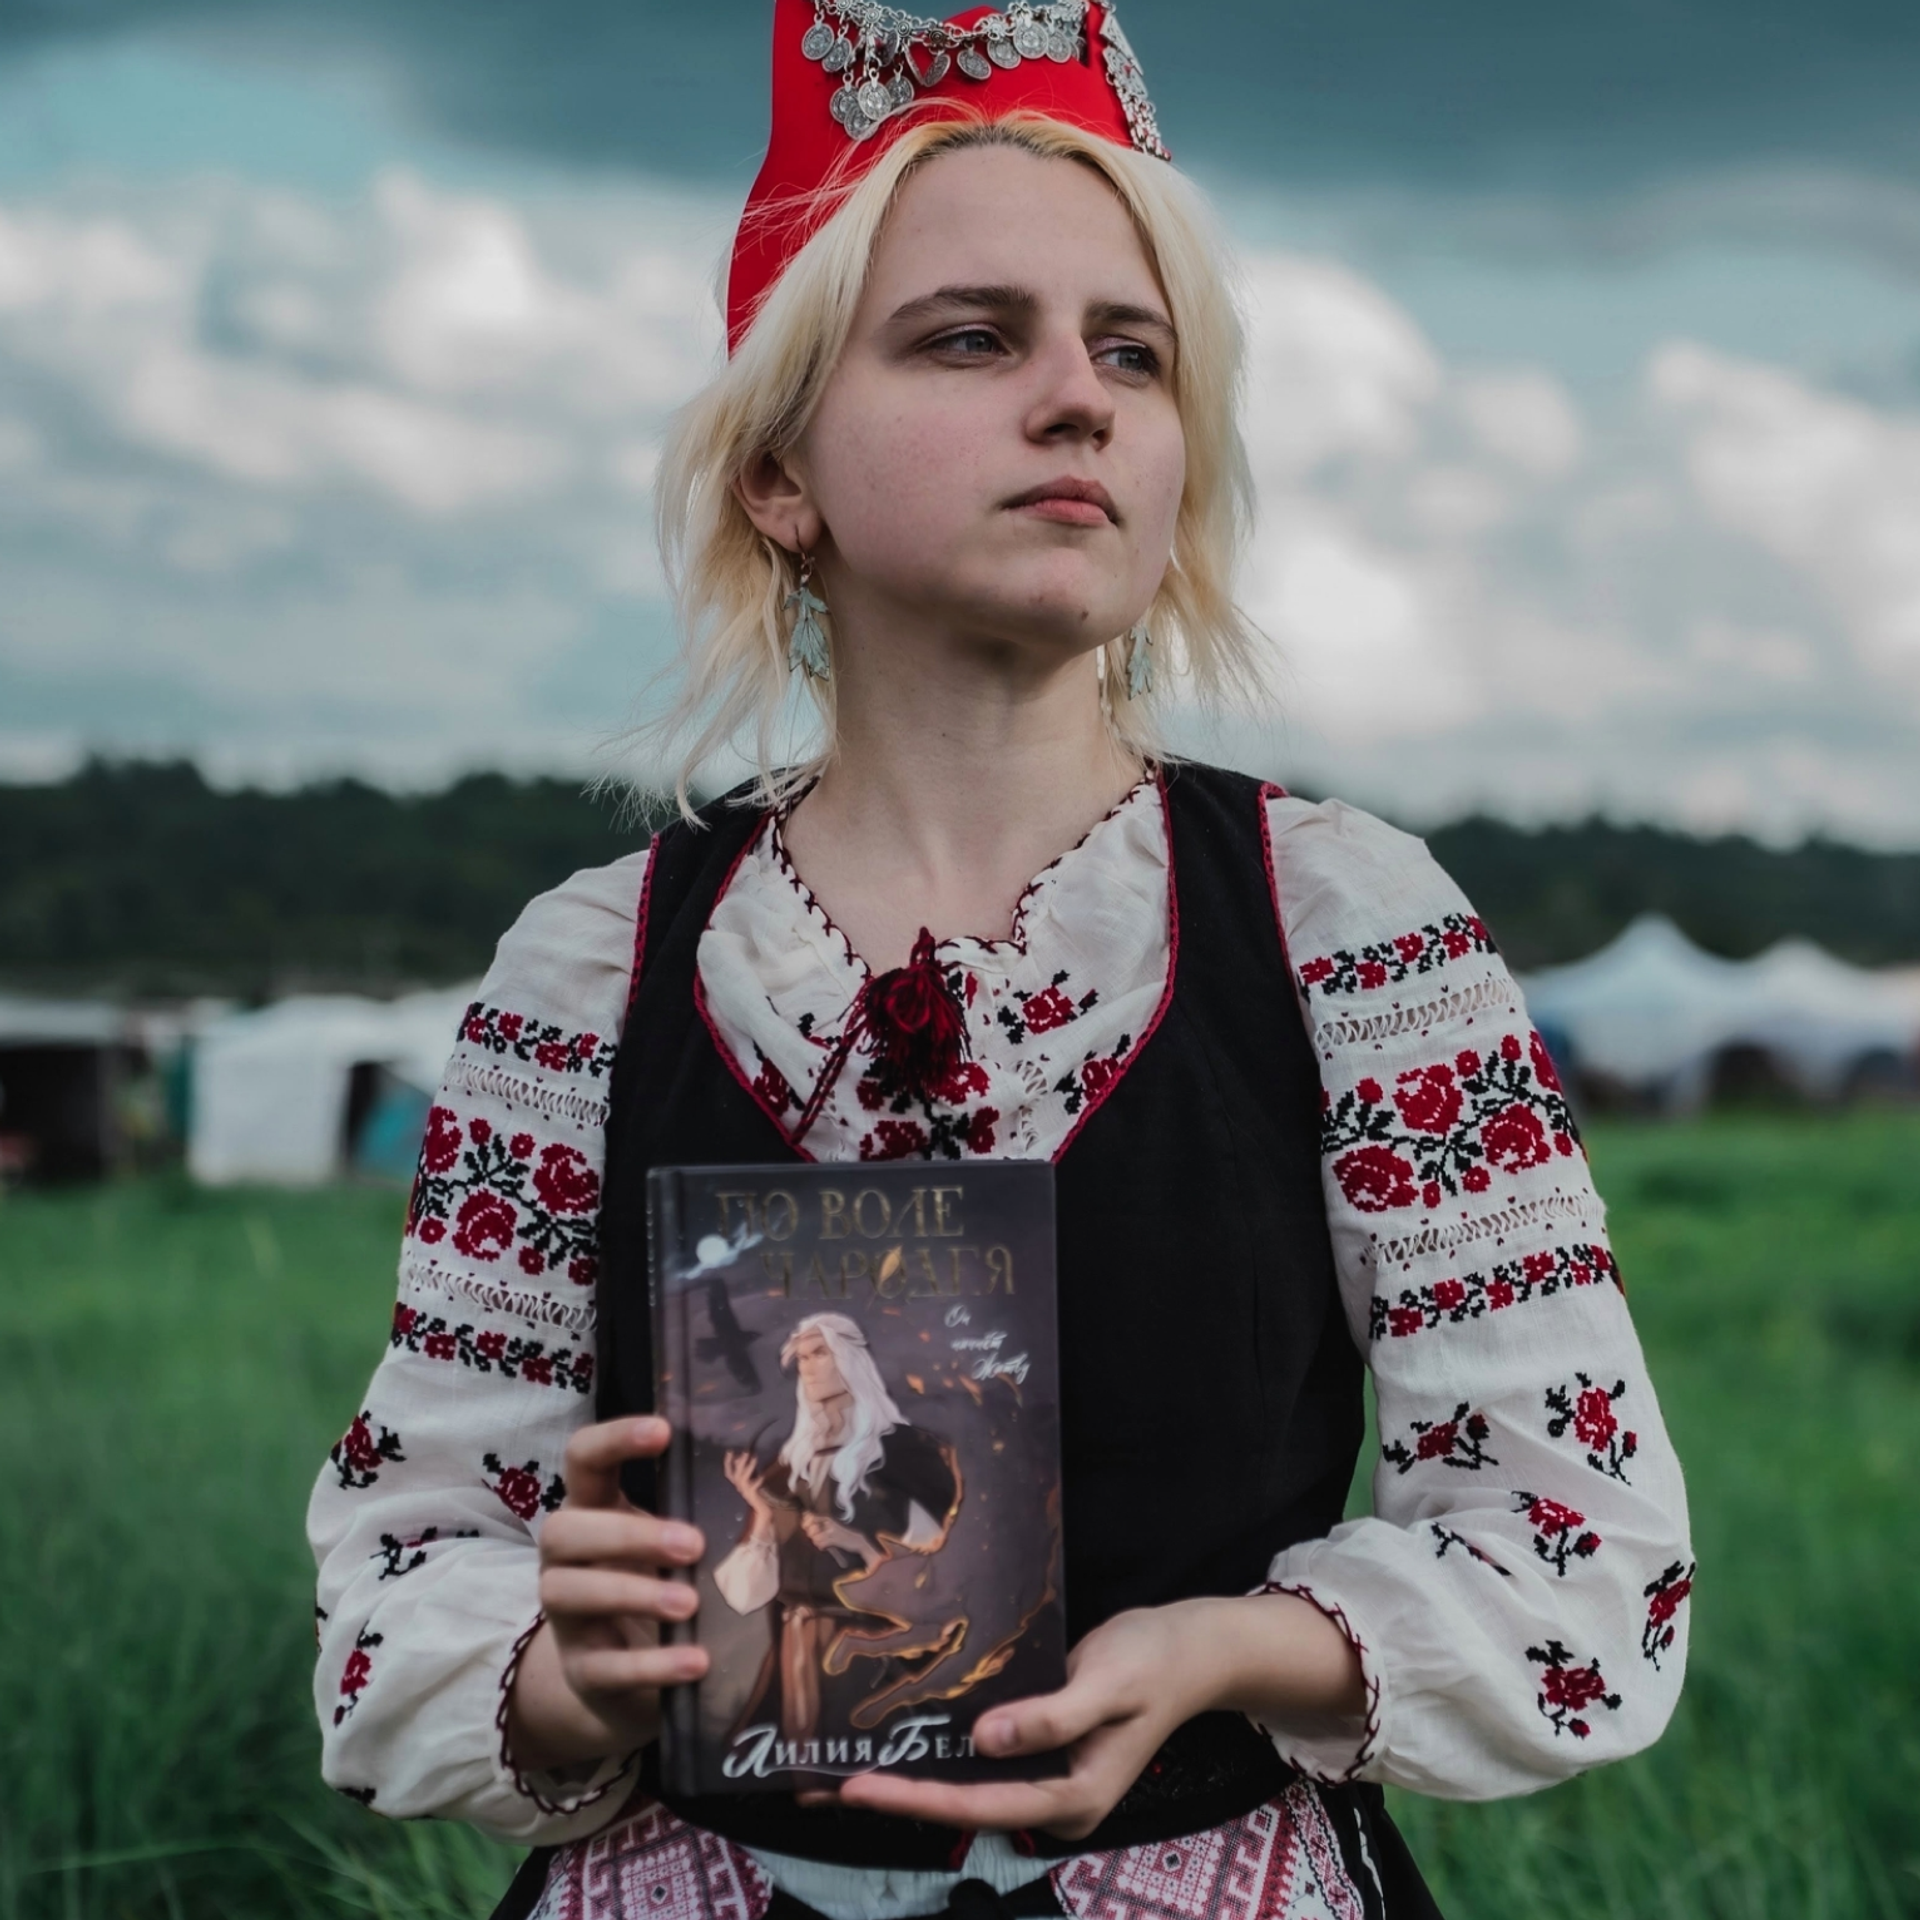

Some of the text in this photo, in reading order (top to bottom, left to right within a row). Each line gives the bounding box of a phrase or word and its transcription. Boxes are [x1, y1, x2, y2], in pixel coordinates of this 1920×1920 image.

[715, 1184, 965, 1242] ПО ВОЛЕ
[722, 1714, 977, 1778] Лилия Бел
